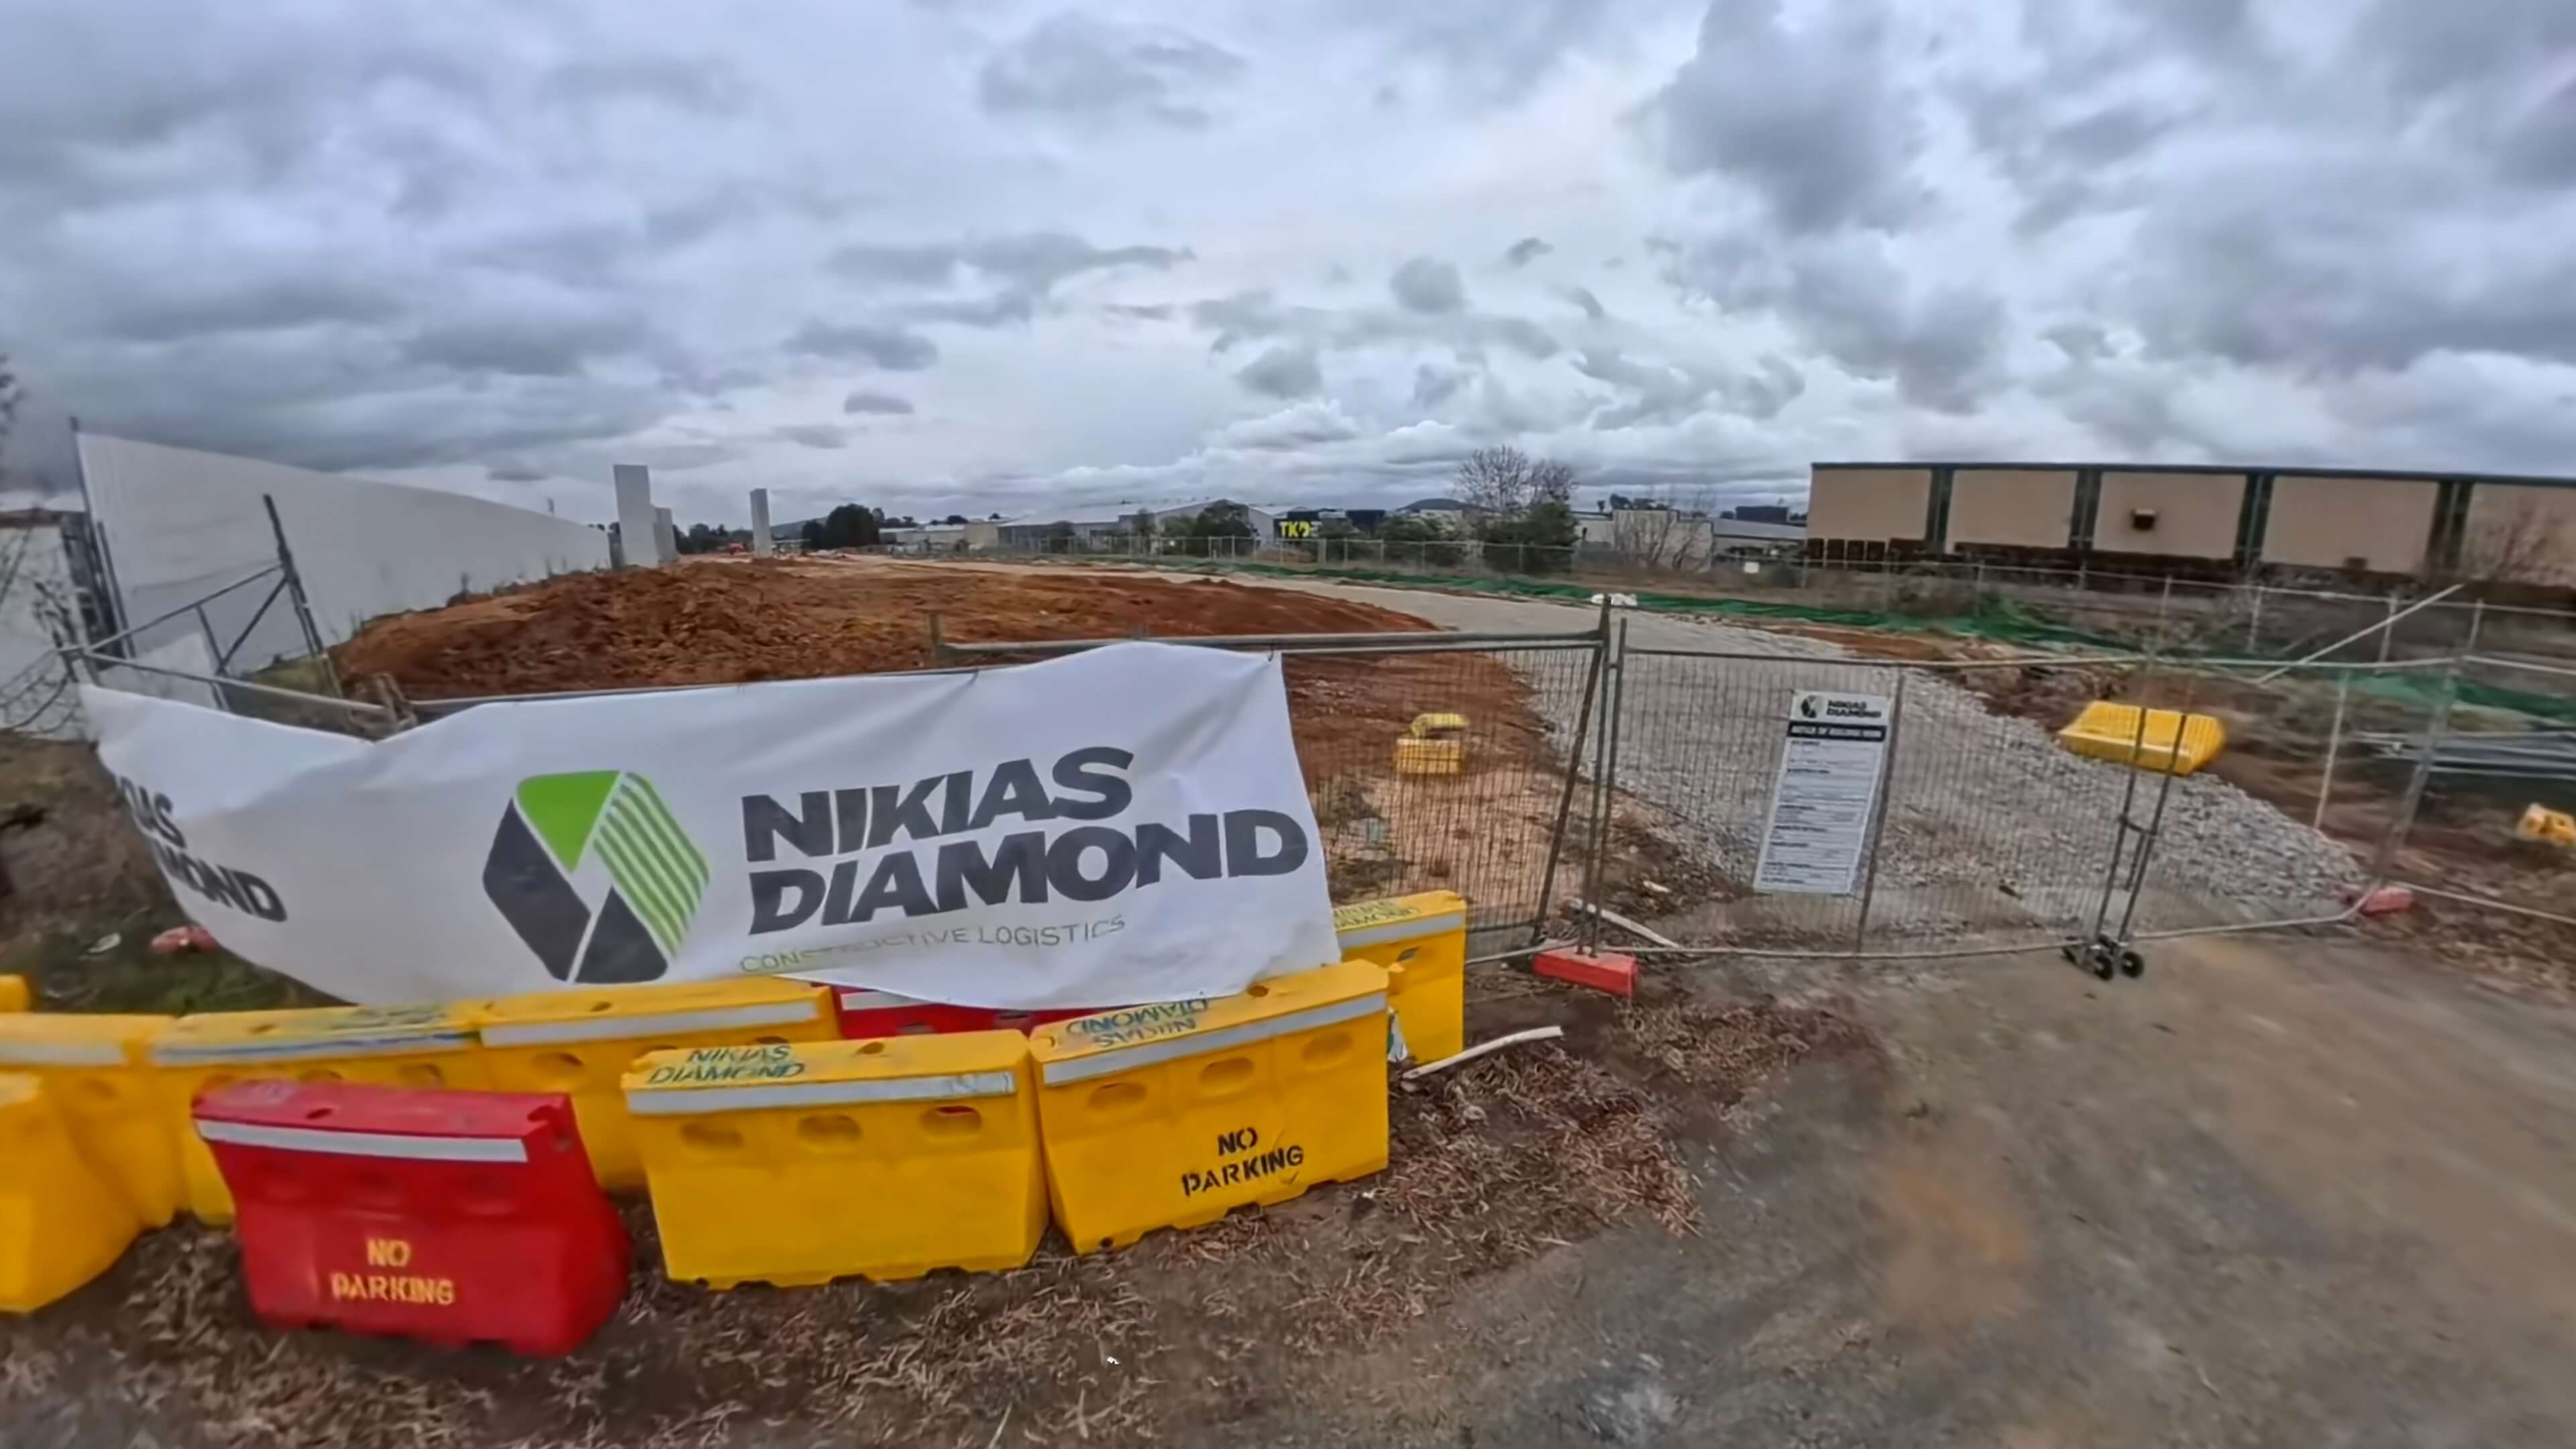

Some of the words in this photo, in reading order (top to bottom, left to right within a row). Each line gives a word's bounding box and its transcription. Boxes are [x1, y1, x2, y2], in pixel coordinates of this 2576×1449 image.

[741, 747, 1134, 862] NIKIAS
[749, 809, 1309, 934] DIAMOND
[978, 914, 1126, 947] LOGISTICS
[1218, 1127, 1258, 1156] NO
[1181, 1145, 1303, 1196] PARKING
[367, 1238, 411, 1267] NO
[332, 1272, 454, 1305] PARKING
